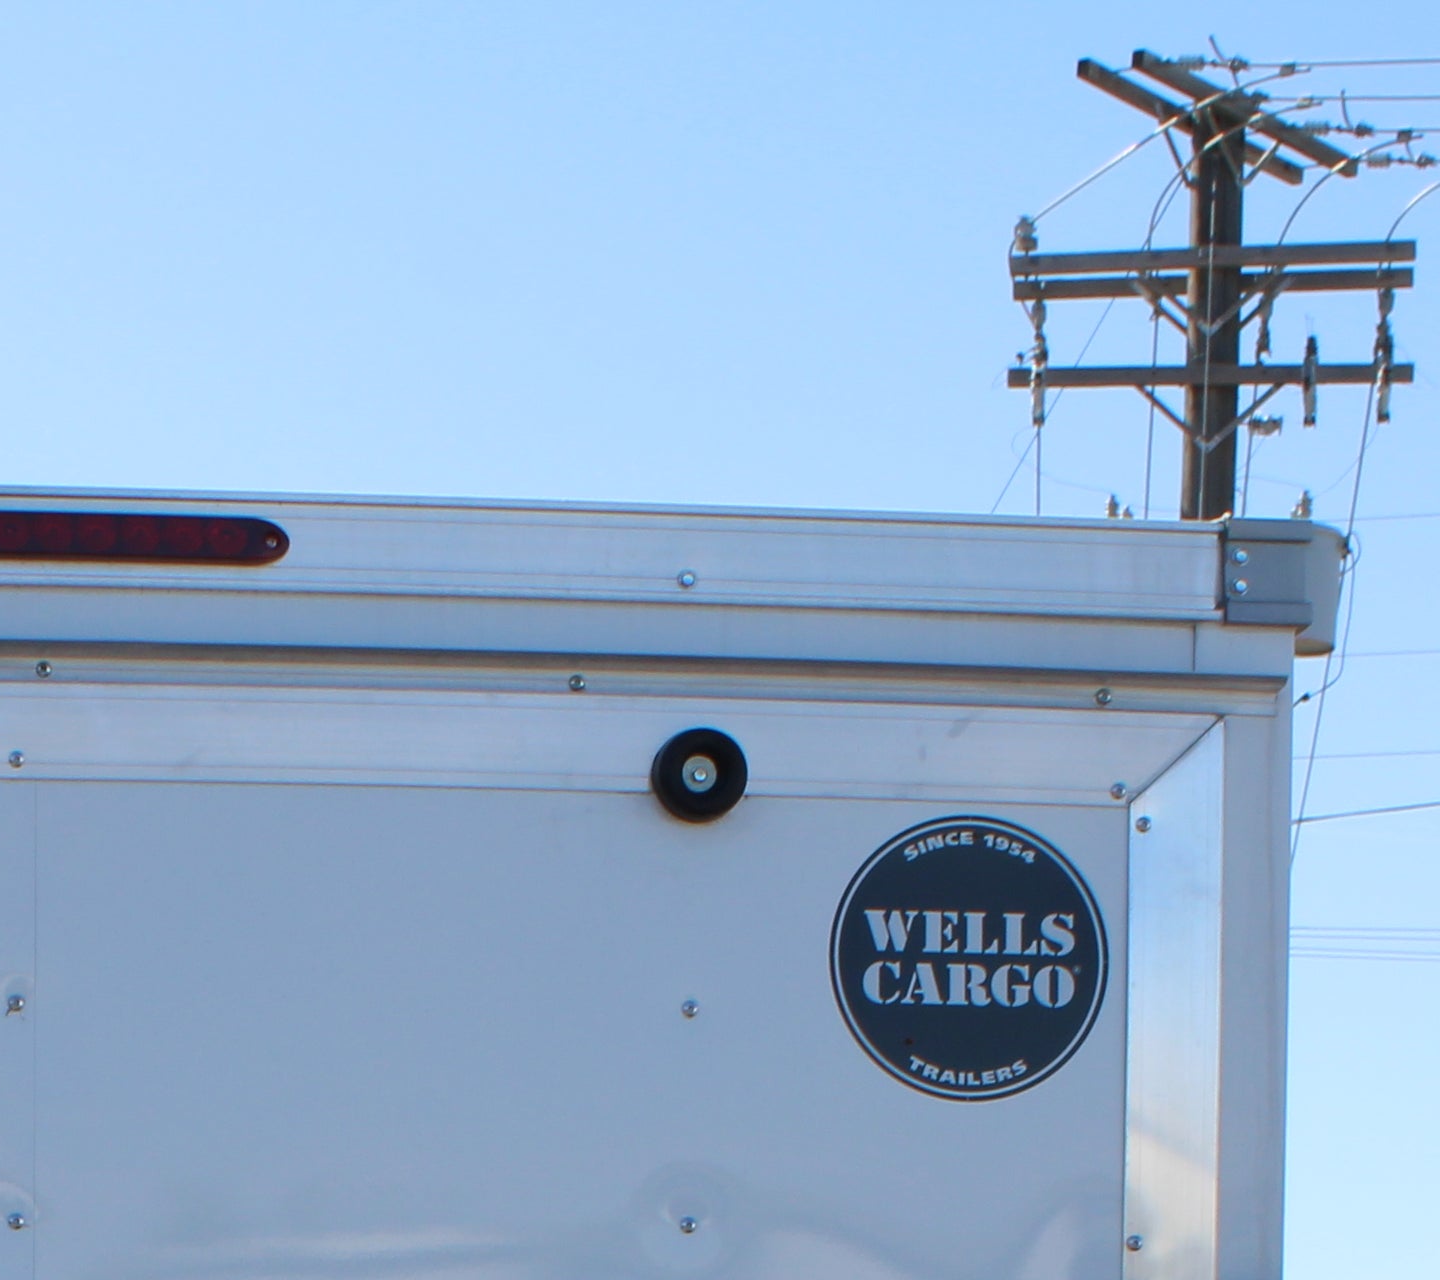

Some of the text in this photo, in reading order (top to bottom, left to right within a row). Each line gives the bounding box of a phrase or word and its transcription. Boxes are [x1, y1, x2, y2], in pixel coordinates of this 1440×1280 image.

[903, 831, 1038, 864] SINCE 1954
[863, 908, 1076, 957] WELLS
[862, 960, 1076, 1008] CARGO
[908, 1054, 1028, 1086] TRAILERS
